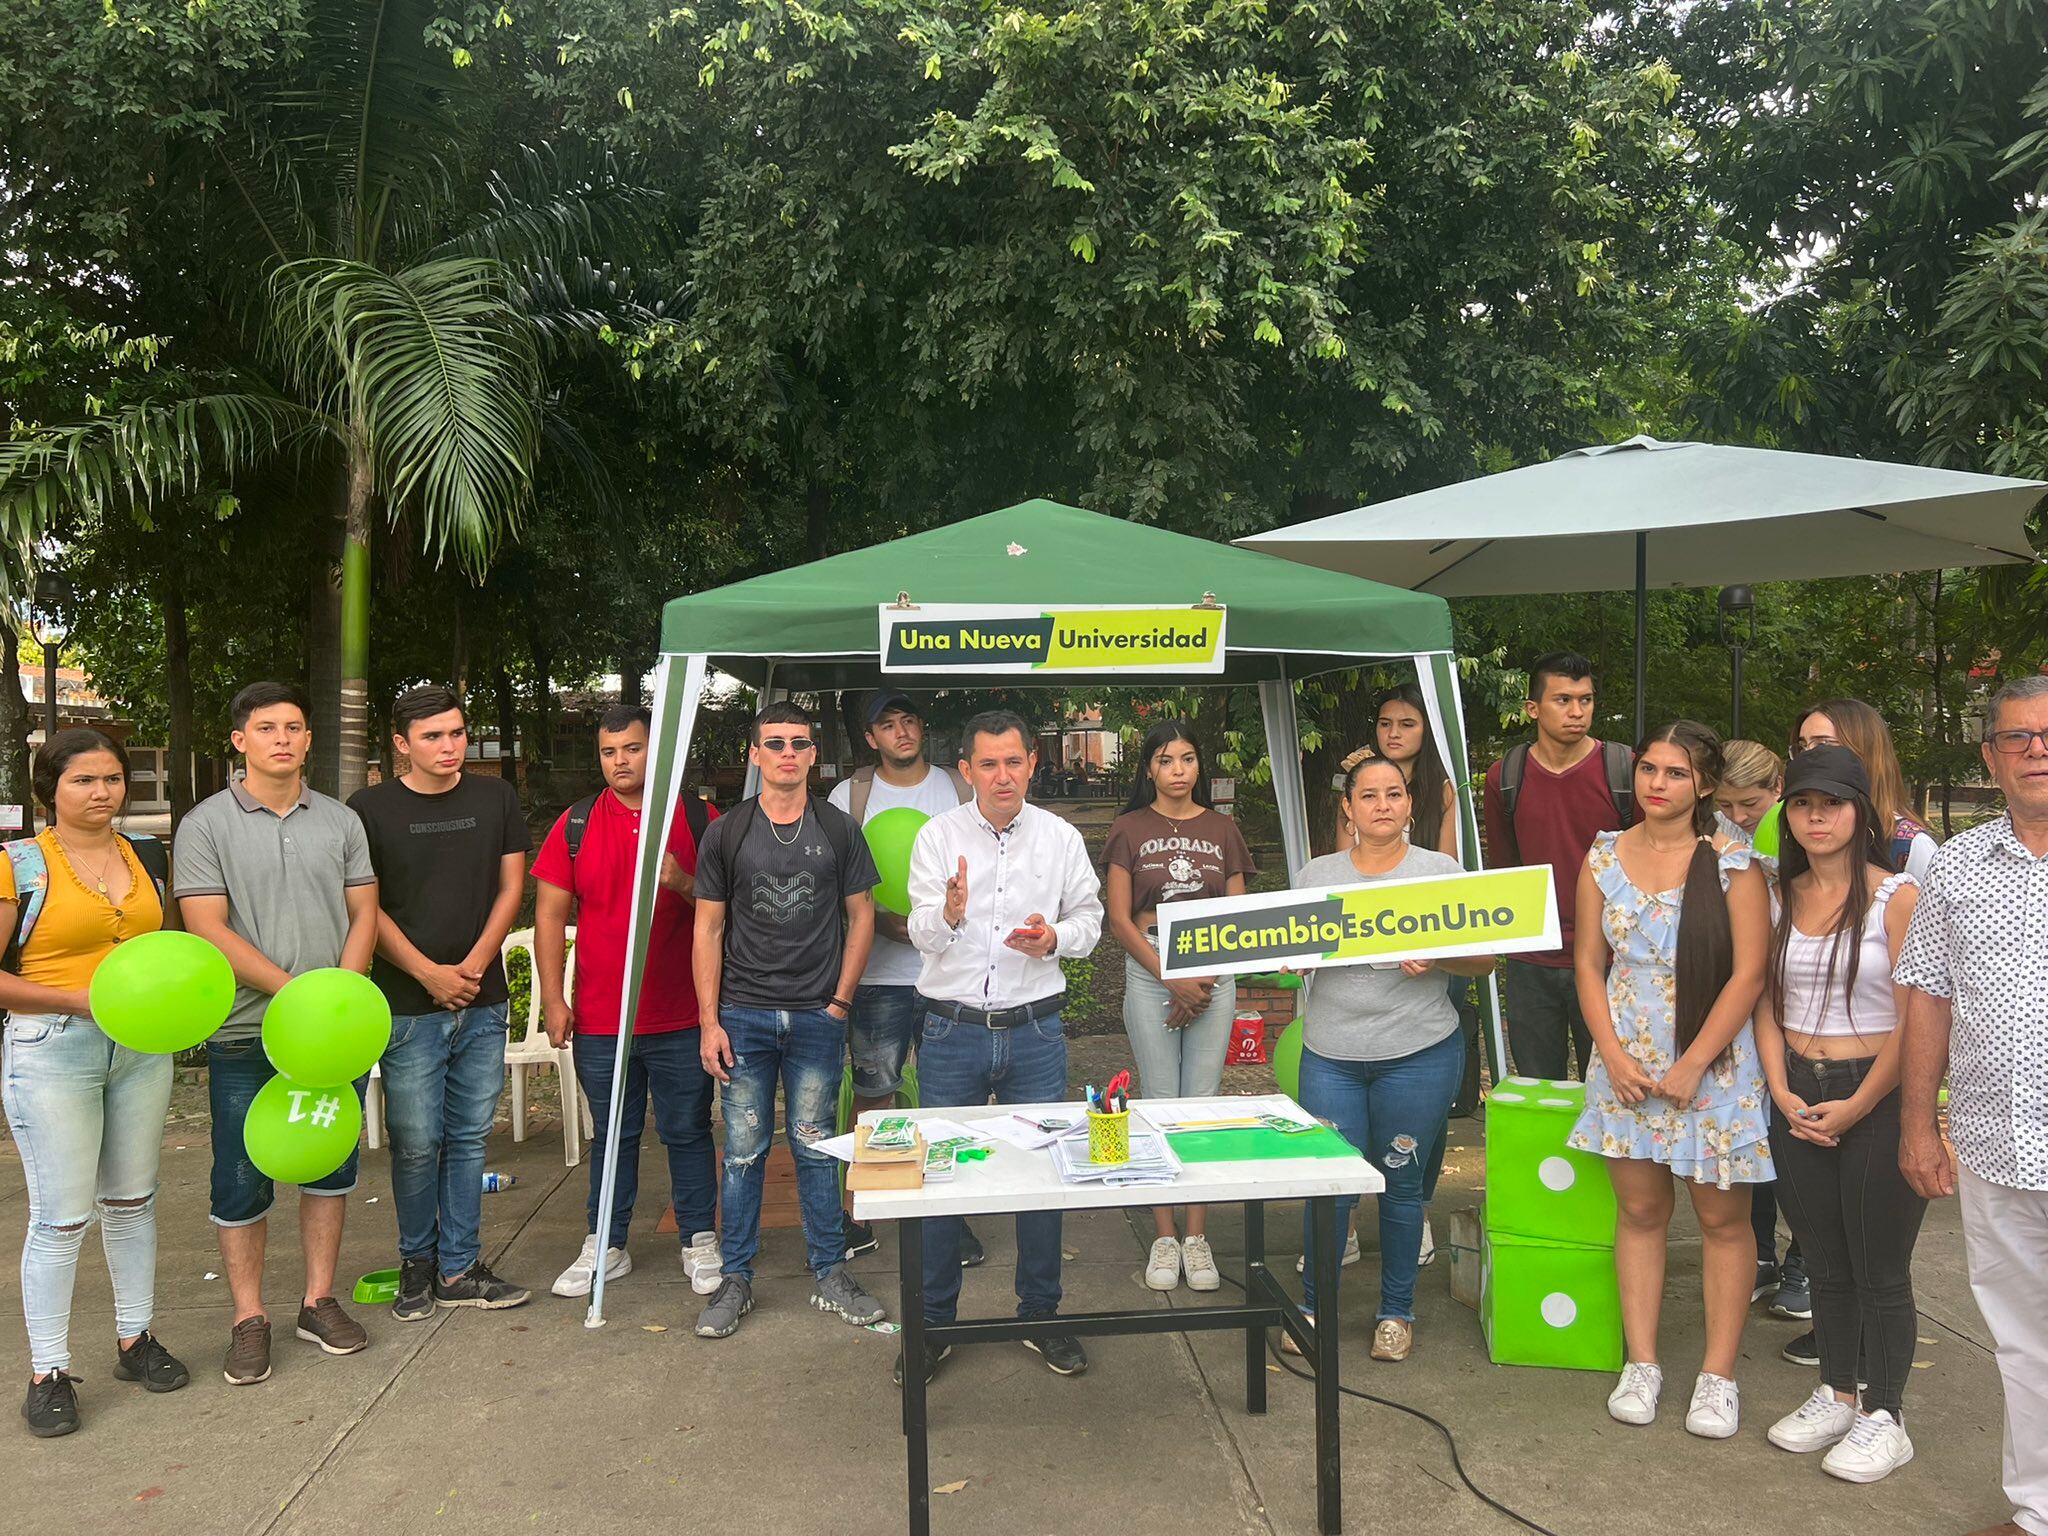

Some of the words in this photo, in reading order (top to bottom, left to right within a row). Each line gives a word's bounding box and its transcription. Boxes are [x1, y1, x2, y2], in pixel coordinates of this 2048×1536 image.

[899, 629, 950, 650] Una
[959, 629, 1041, 649] Nueva
[1058, 627, 1207, 649] Universidad
[409, 816, 477, 834] CONSCIOUSNESS
[1139, 837, 1224, 860] COLORADO
[1176, 902, 1515, 955] #ElCambioEsConUno
[287, 1090, 340, 1128] #1
